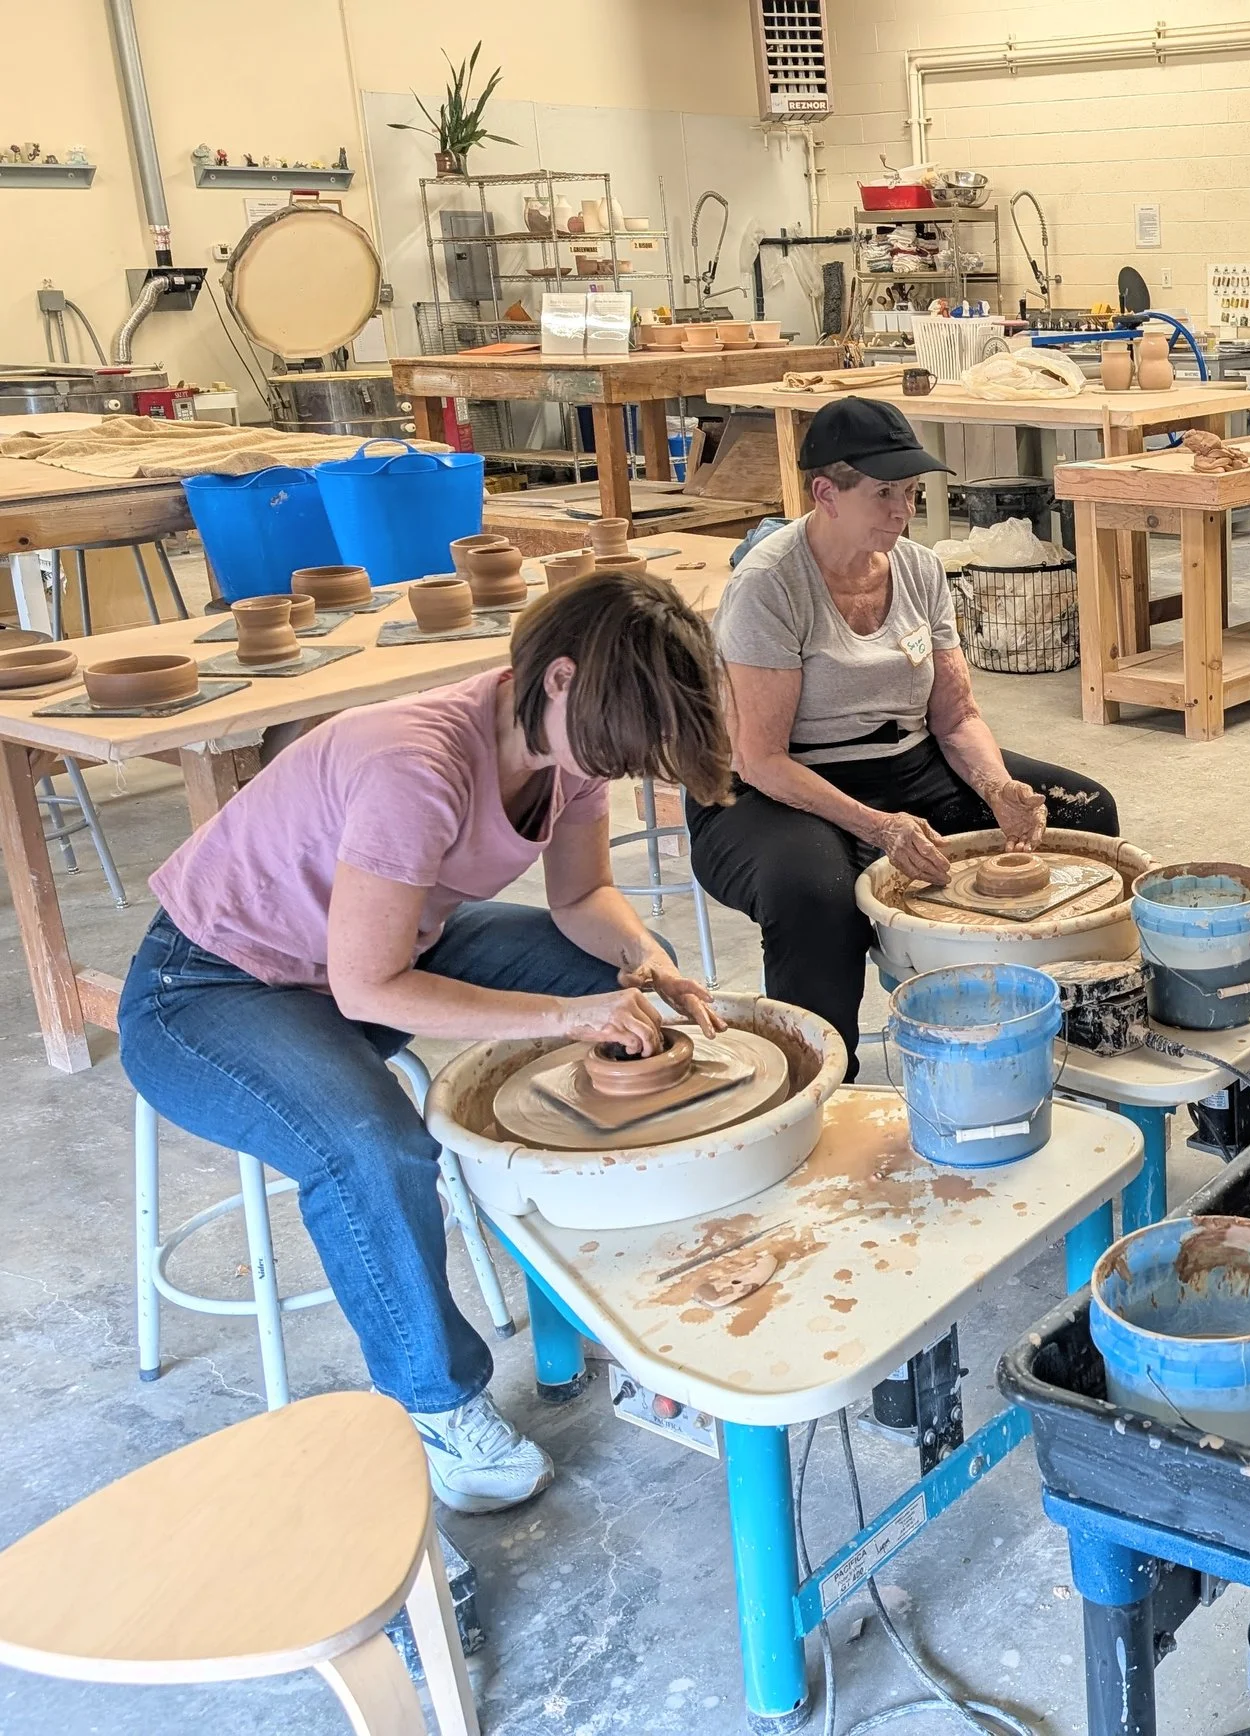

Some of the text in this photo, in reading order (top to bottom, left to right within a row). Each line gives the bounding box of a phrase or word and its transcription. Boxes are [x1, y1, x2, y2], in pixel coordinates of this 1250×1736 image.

[789, 101, 826, 109] REZNOR
[653, 1415, 683, 1433] PACIFICA
[834, 1550, 868, 1582] PACIFICA
